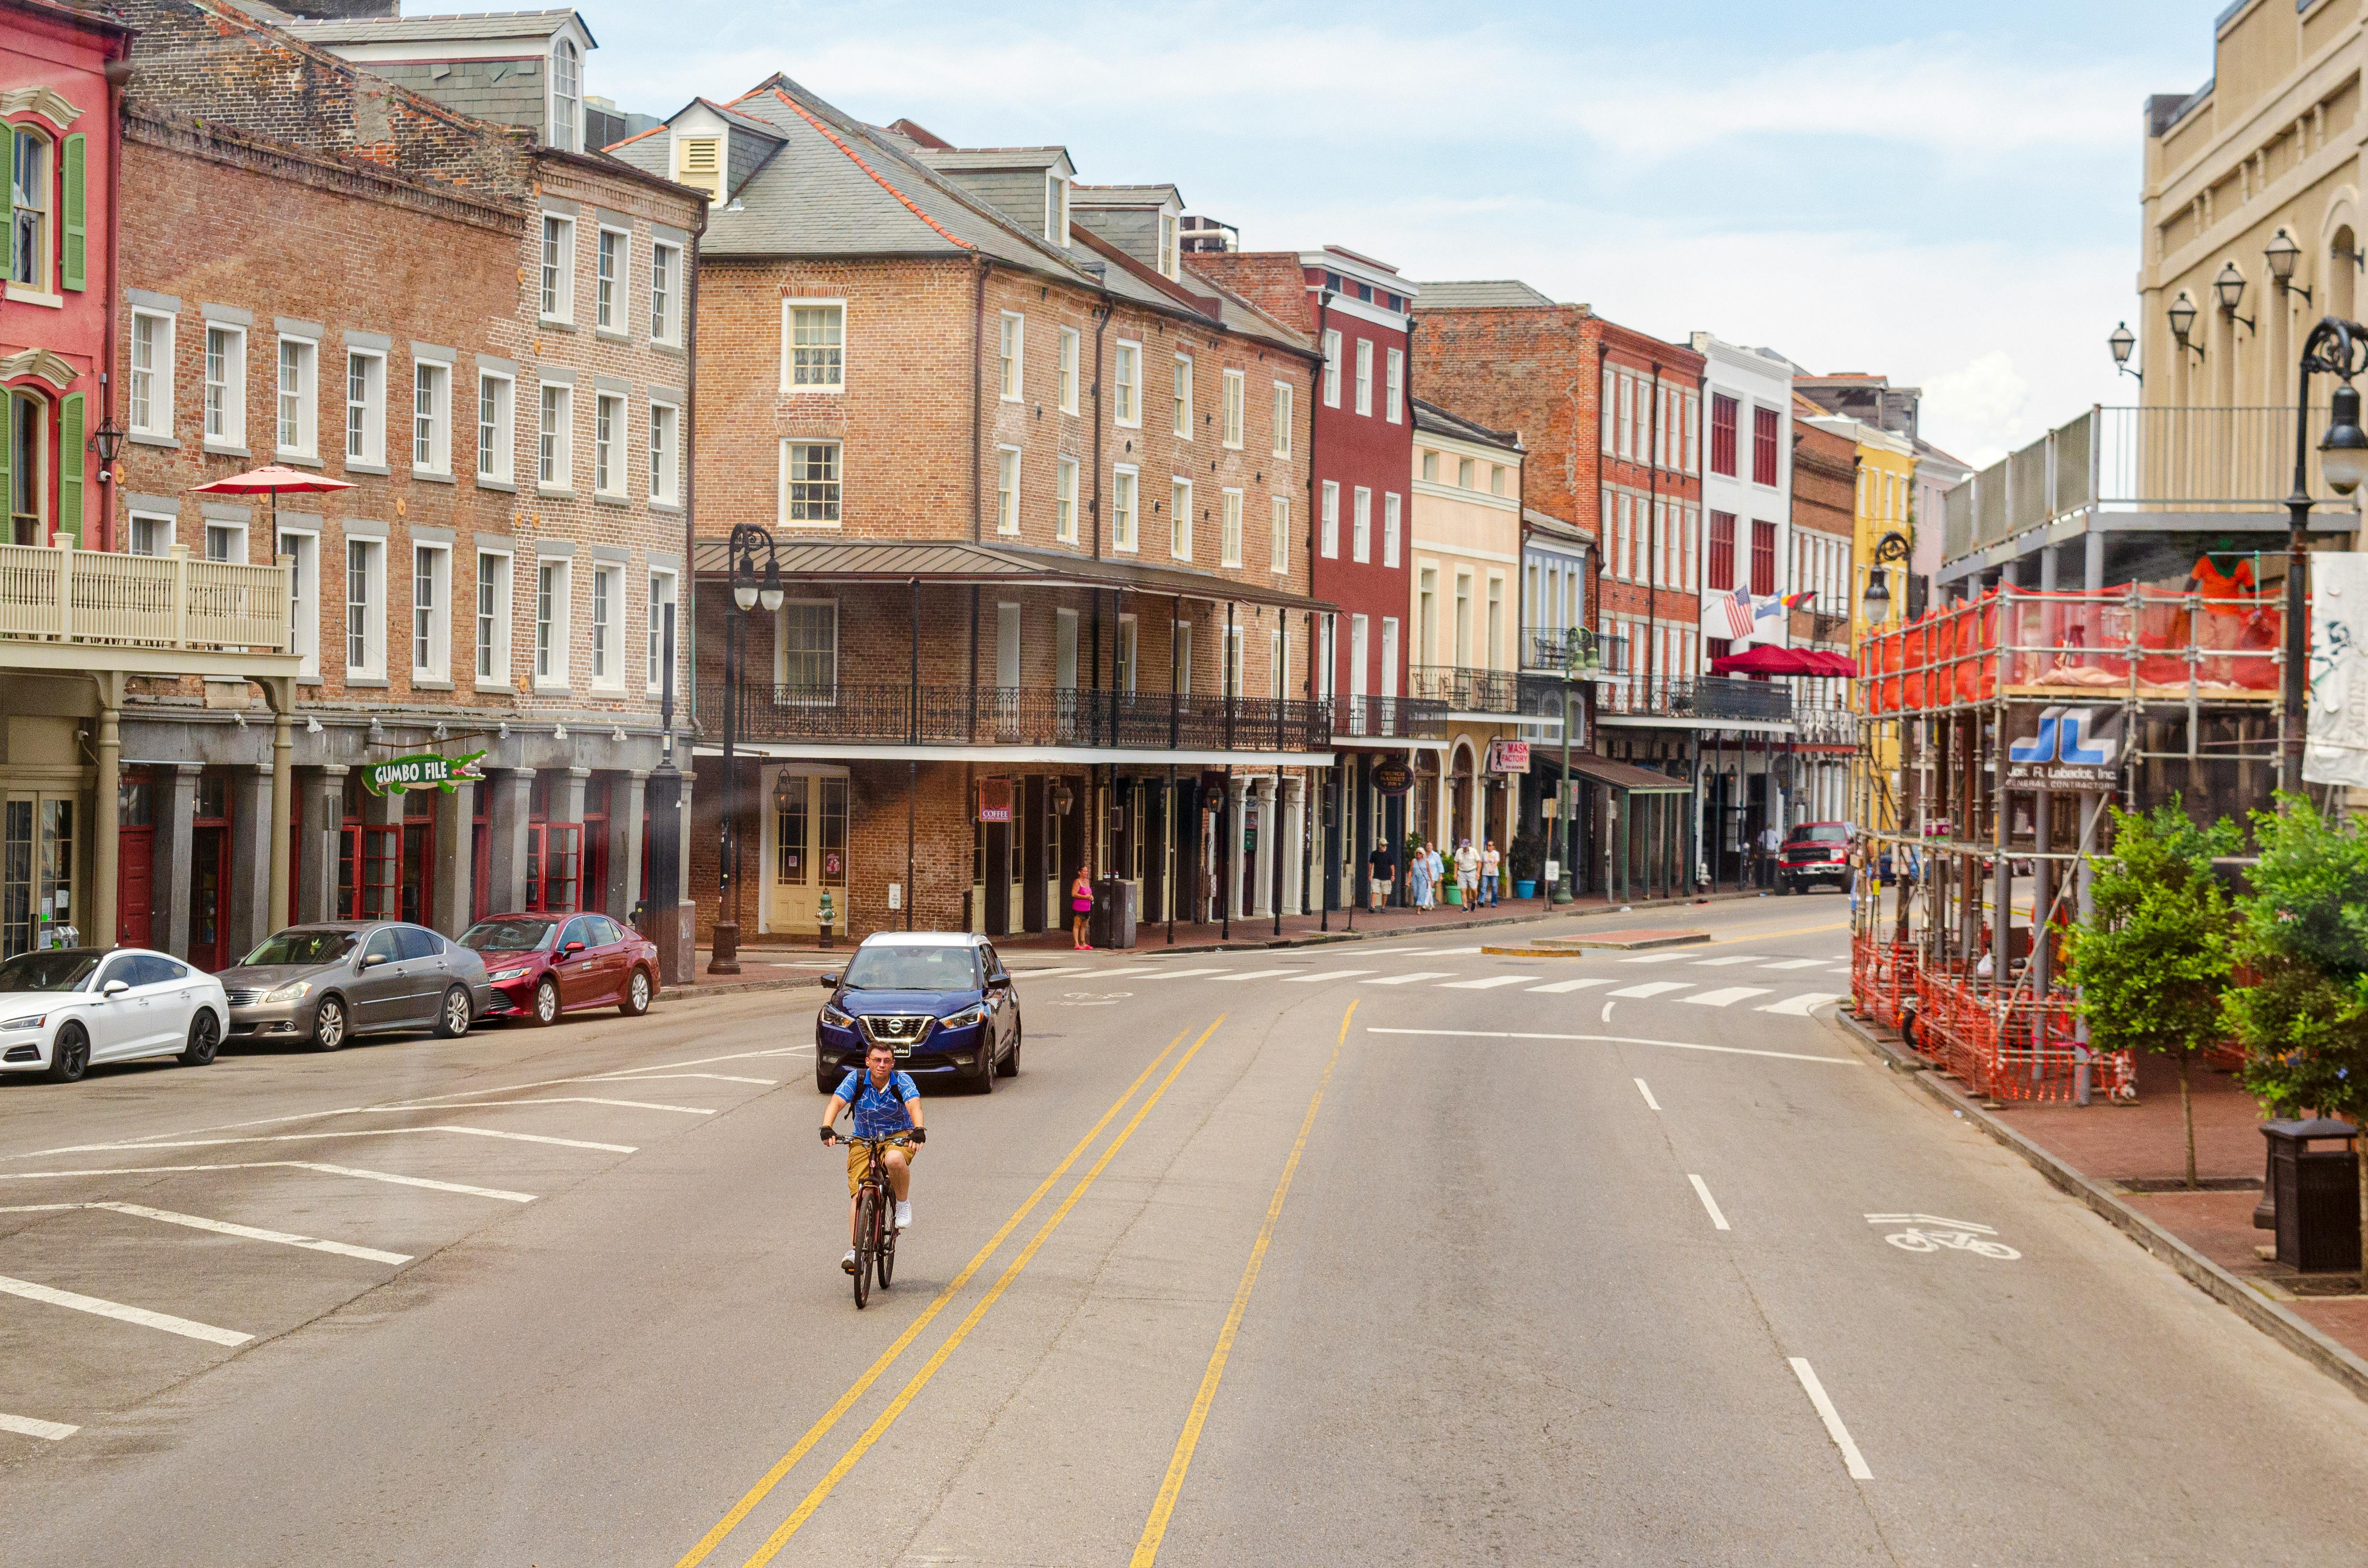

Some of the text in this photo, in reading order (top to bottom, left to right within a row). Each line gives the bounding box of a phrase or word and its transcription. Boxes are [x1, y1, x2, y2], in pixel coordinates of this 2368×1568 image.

[1508, 743, 1529, 754] MASK
[375, 762, 447, 783] GUMBO FILE
[2098, 769, 2117, 780] Inc.
[2050, 780, 2117, 790] CONTRACTORS
